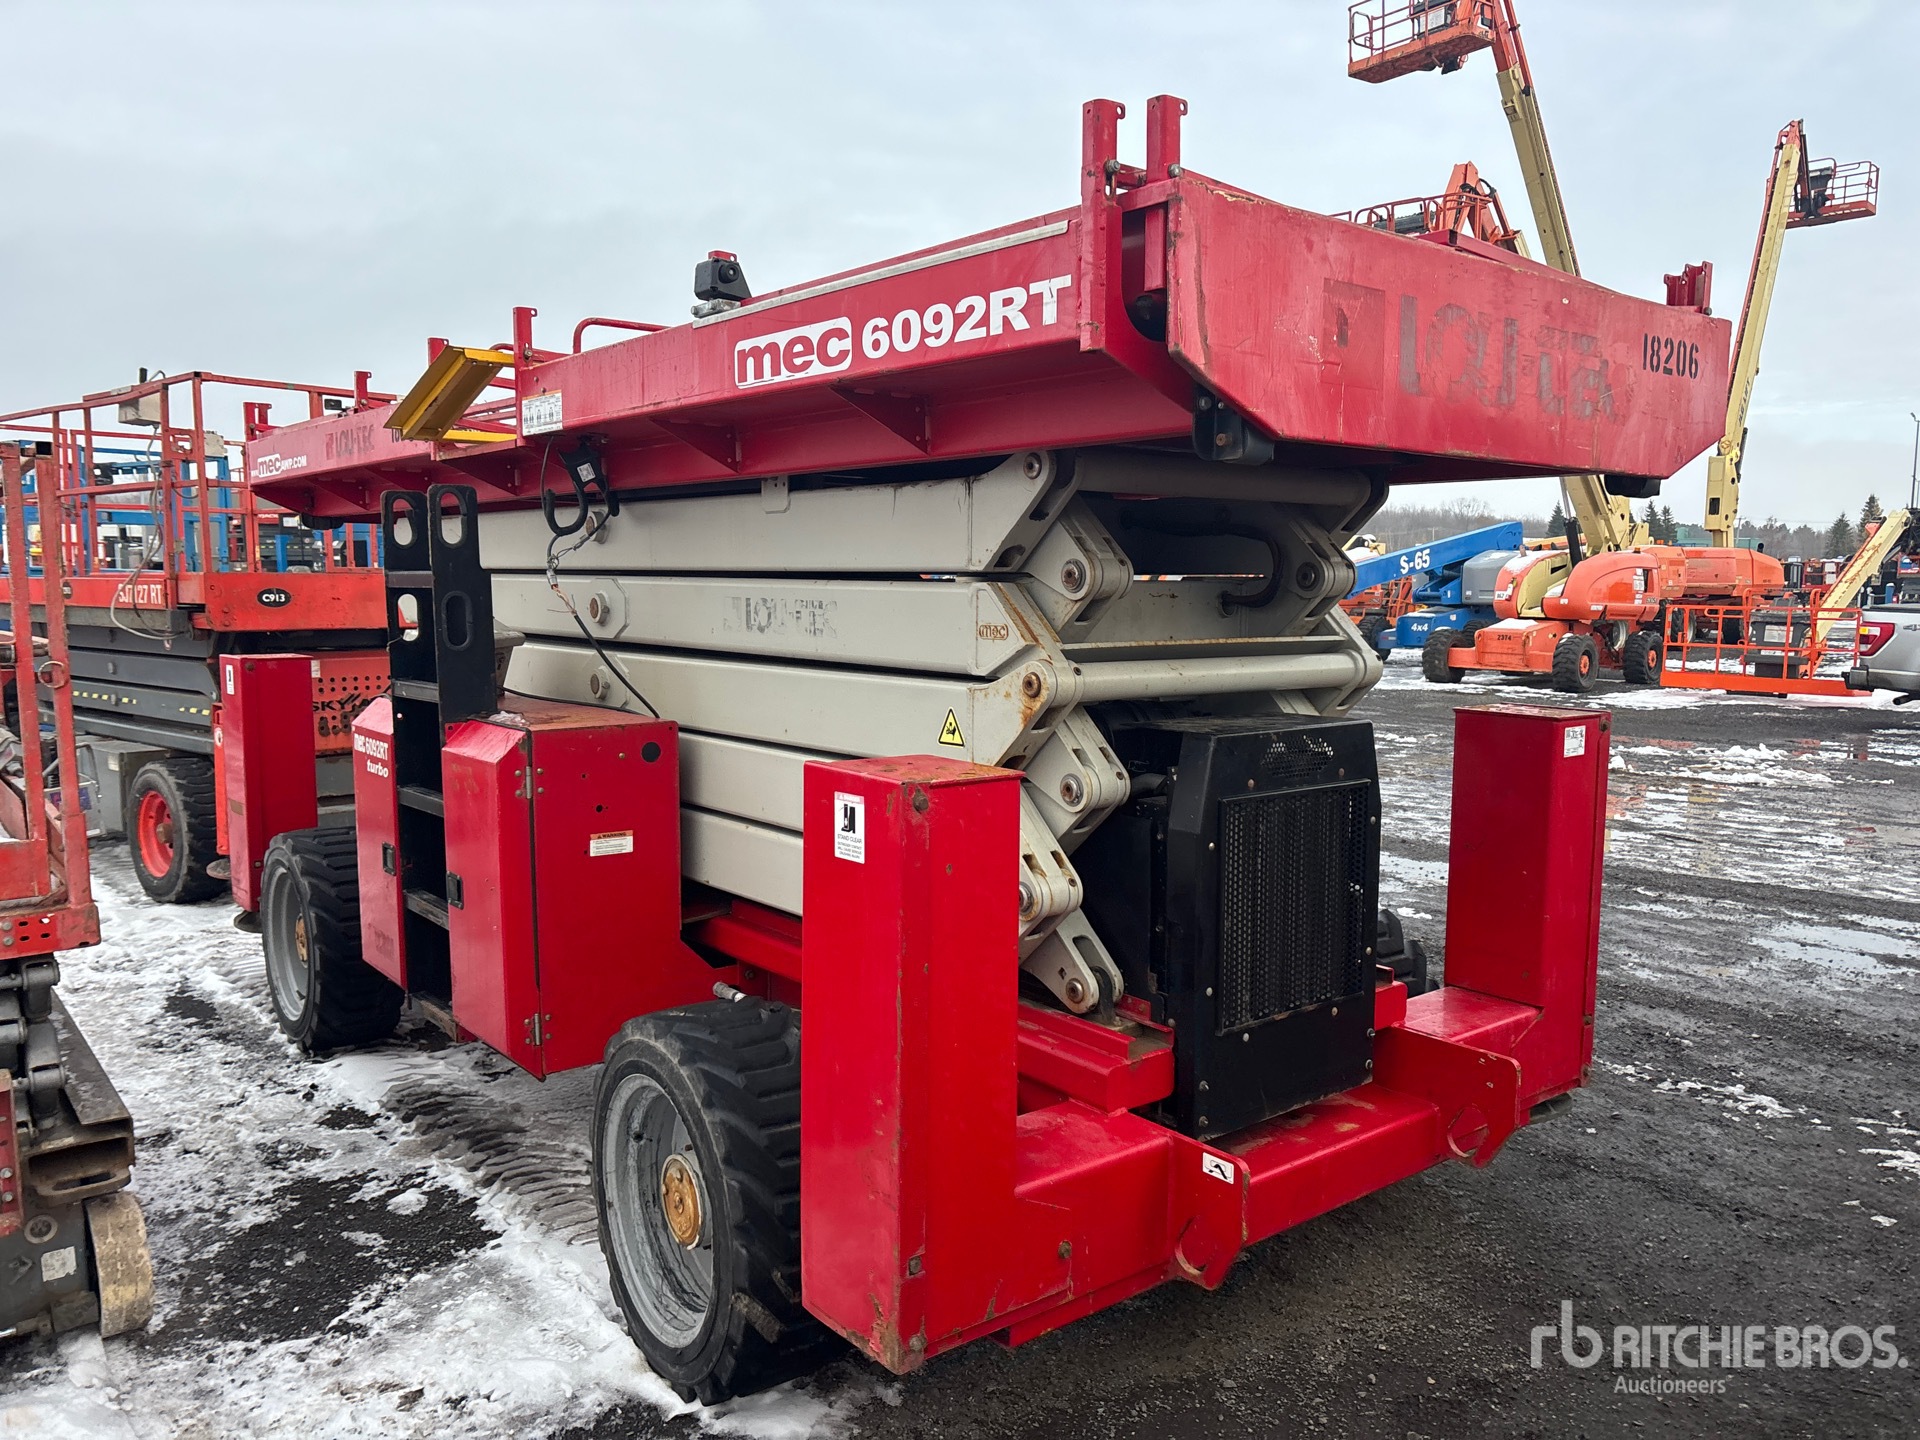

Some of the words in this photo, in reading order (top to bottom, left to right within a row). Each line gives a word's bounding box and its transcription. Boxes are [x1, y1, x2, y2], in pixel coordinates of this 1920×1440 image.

[737, 327, 850, 384] mec
[862, 274, 1071, 359] 6092RT
[1642, 333, 1699, 379] 18206
[1400, 548, 1430, 575] S-65
[150, 584, 163, 605] RT
[262, 593, 286, 603] C913
[1411, 623, 1428, 632] 4x4
[365, 737, 389, 761] 6092RT
[366, 759, 389, 778] turbo
